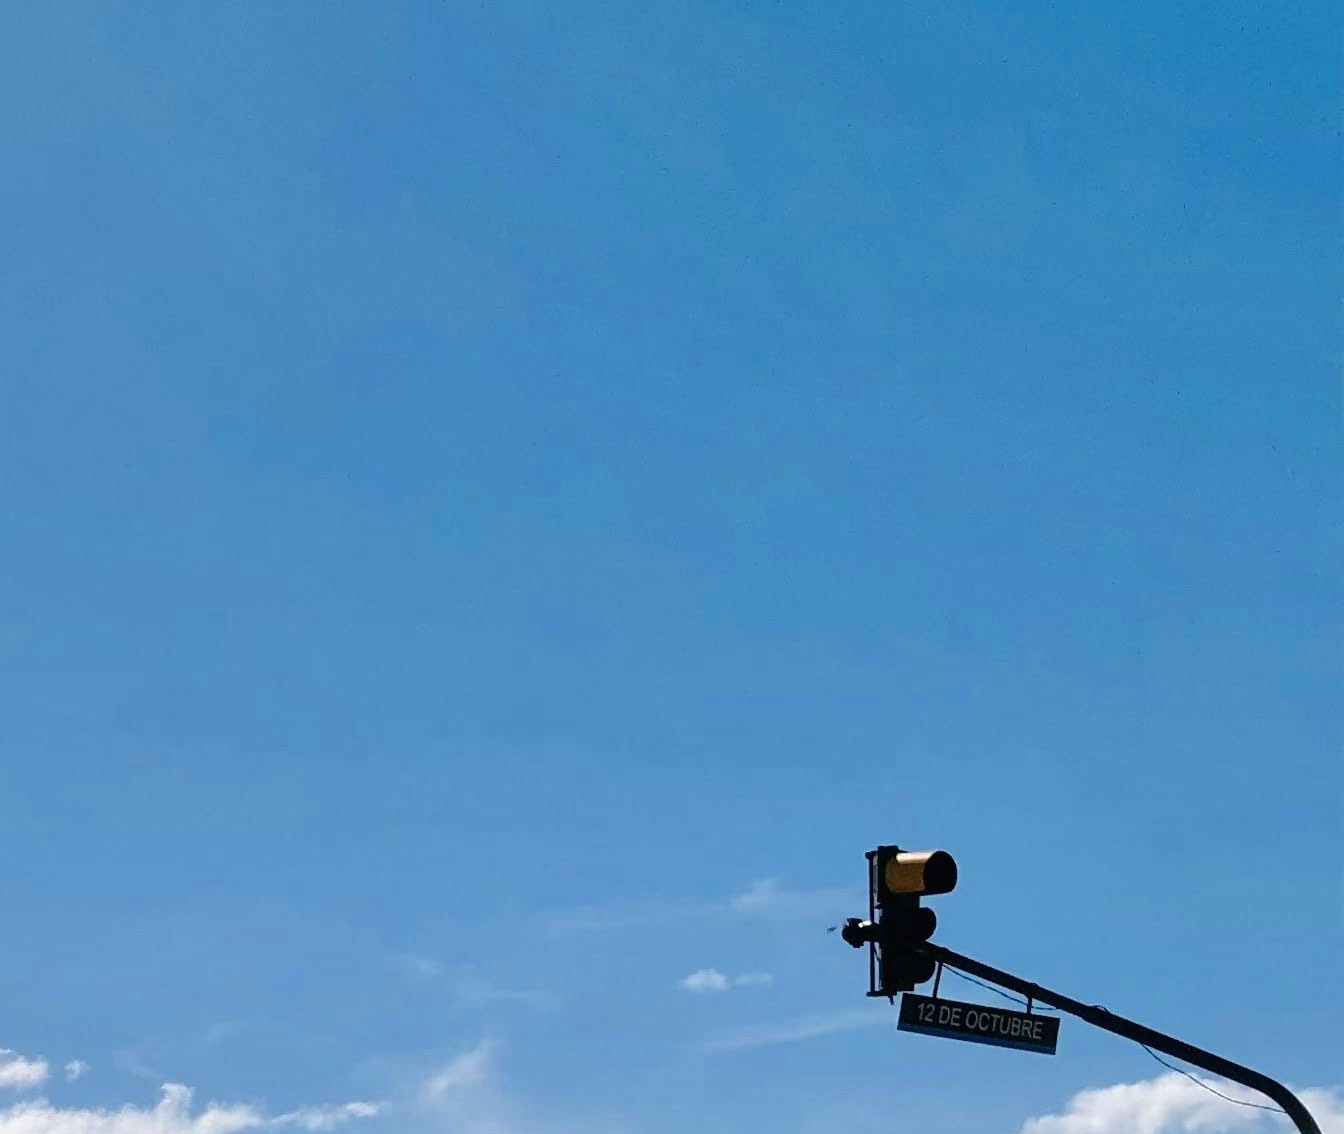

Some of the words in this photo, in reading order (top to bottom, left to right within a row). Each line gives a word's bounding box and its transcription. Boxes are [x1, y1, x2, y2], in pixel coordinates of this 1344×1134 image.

[917, 1002, 936, 1023] 12
[938, 1005, 962, 1027] DE
[965, 1010, 1045, 1040] OCTUBRE
